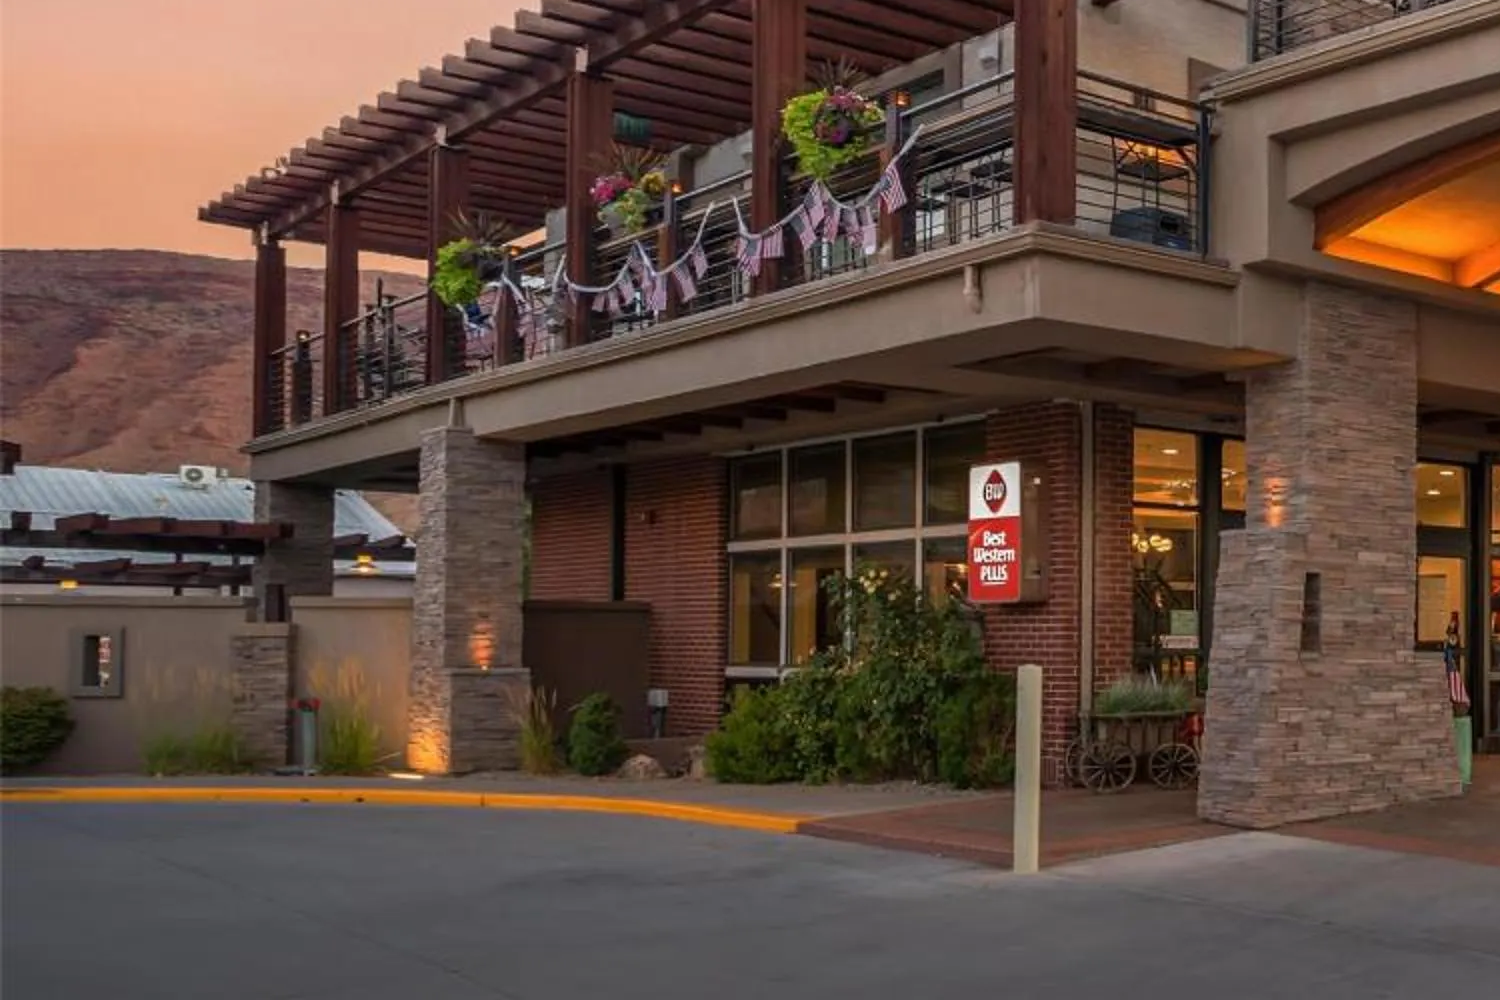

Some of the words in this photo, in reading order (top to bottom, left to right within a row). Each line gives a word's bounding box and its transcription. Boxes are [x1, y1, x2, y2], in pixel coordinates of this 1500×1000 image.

[984, 531, 1006, 546] Best
[974, 547, 1015, 563] Western
[981, 565, 1008, 581] PLUS
